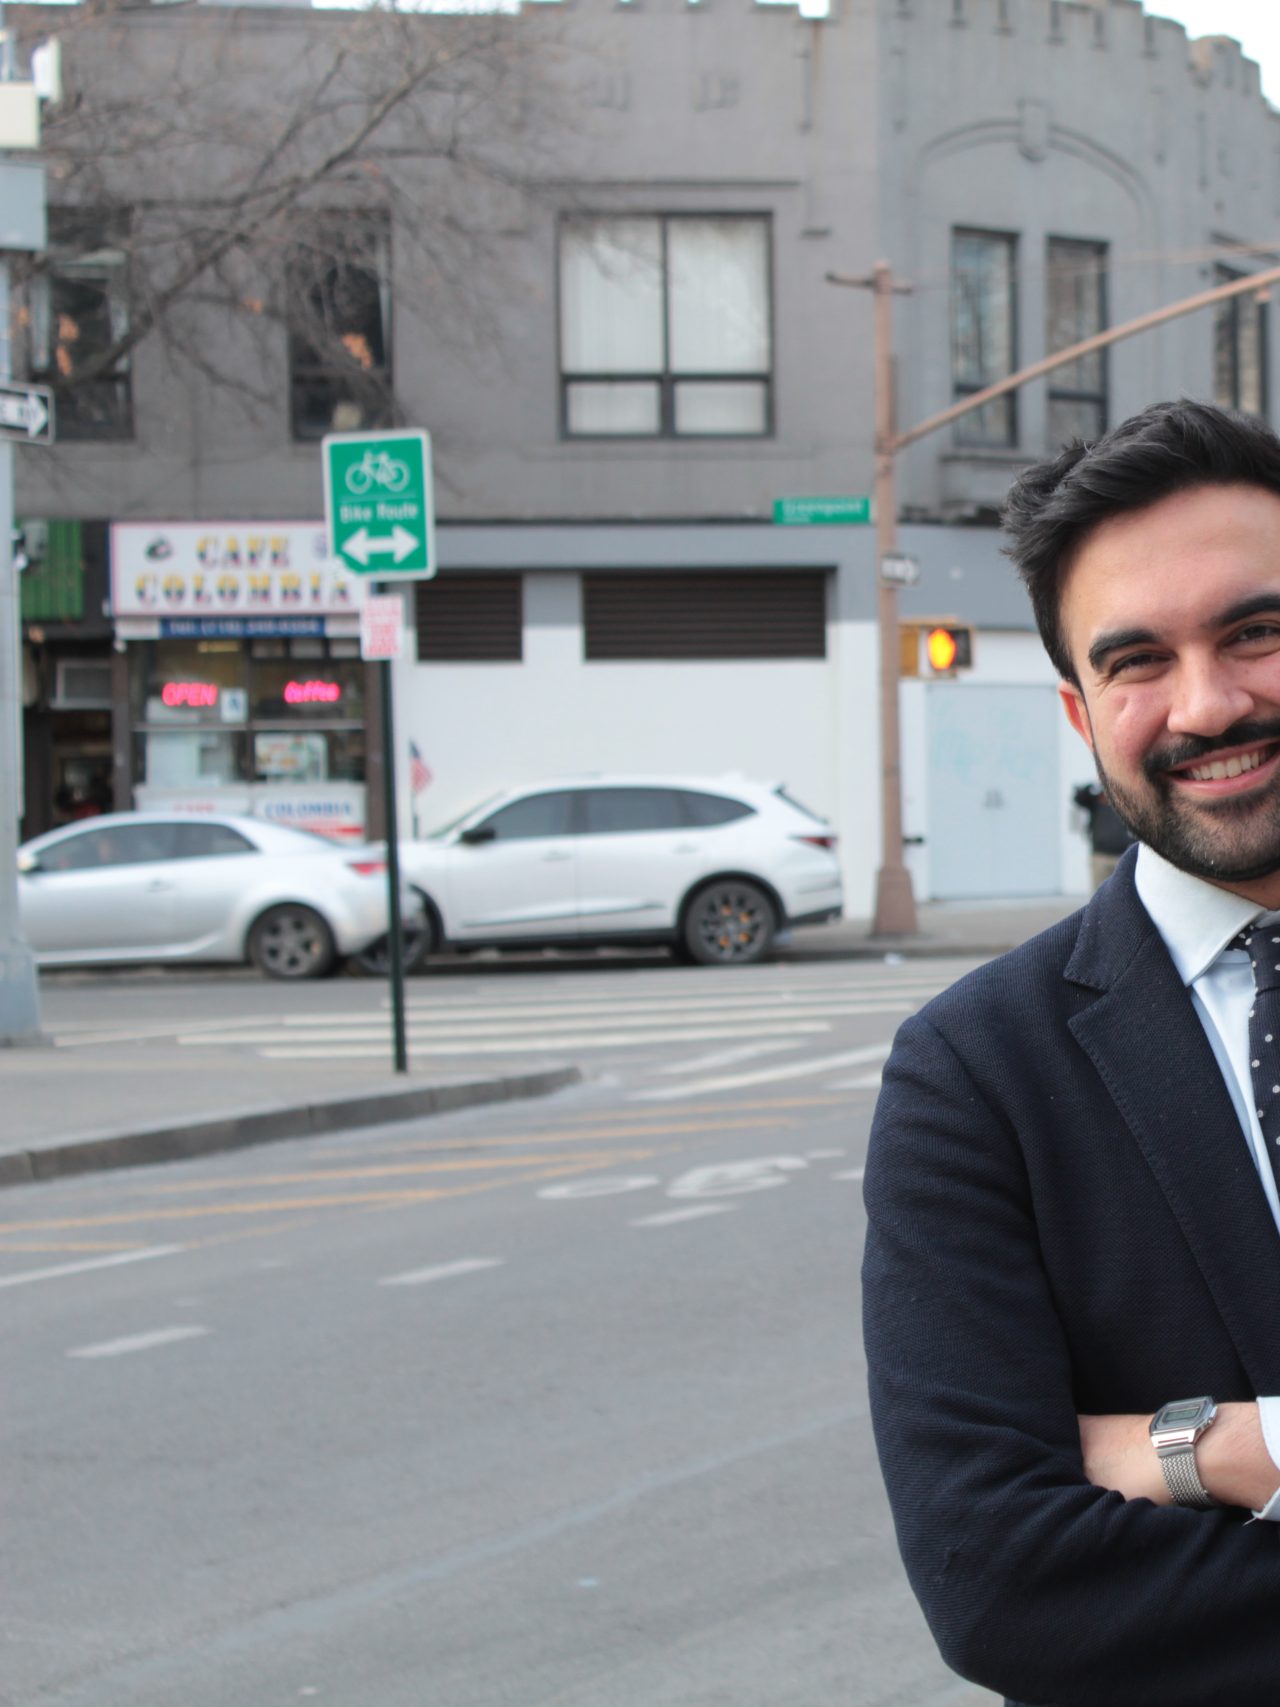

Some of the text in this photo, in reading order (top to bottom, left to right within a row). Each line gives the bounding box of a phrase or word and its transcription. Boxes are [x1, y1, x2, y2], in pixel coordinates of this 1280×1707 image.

[340, 501, 418, 523] Bike Route
[196, 535, 290, 568] CAFE
[135, 572, 350, 604] COLOMBIA
[162, 683, 217, 706] OPEN
